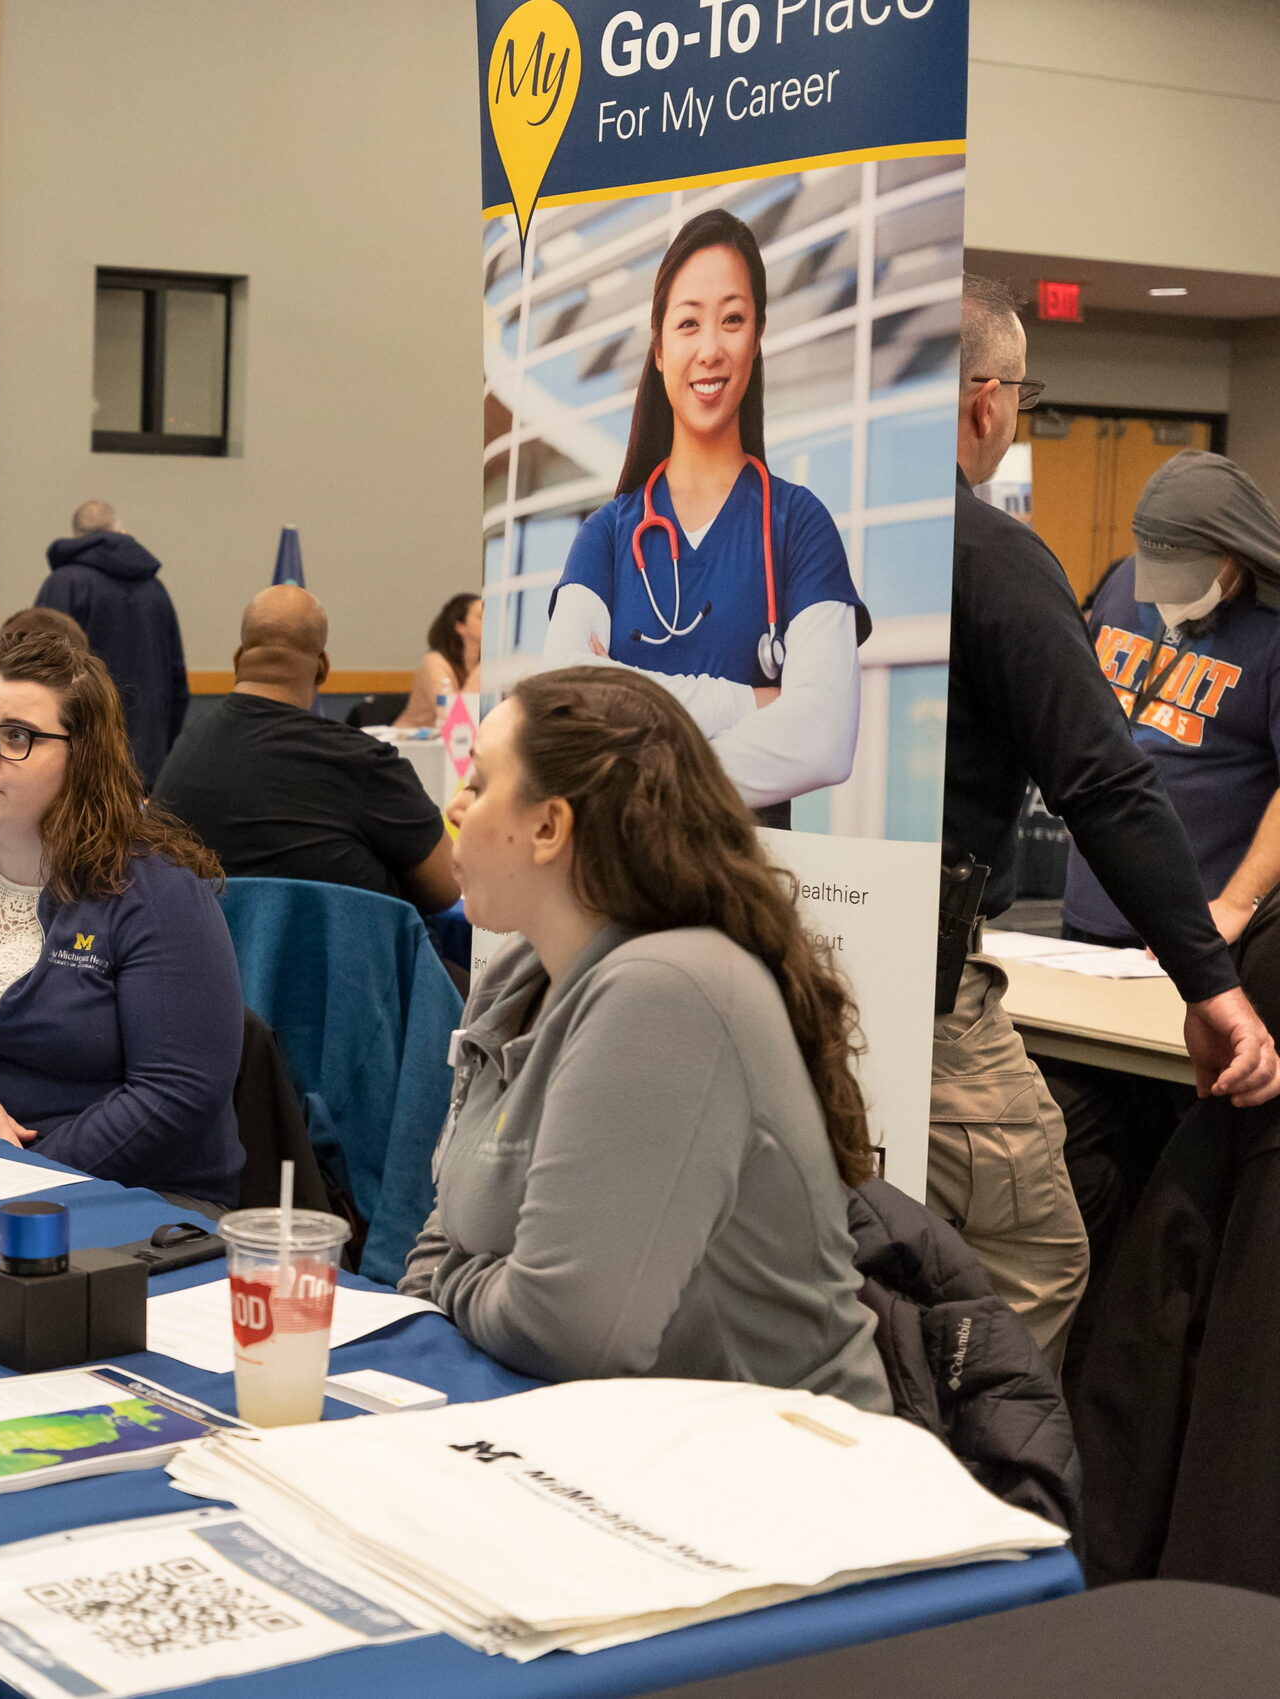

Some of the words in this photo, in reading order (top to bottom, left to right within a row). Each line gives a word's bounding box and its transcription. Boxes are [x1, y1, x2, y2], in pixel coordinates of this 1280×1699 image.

[495, 31, 571, 127] My
[601, 0, 761, 77] Go-To
[598, 100, 650, 142] For
[662, 86, 714, 137] My
[726, 69, 840, 121] Career
[950, 1317, 972, 1377] Columbia
